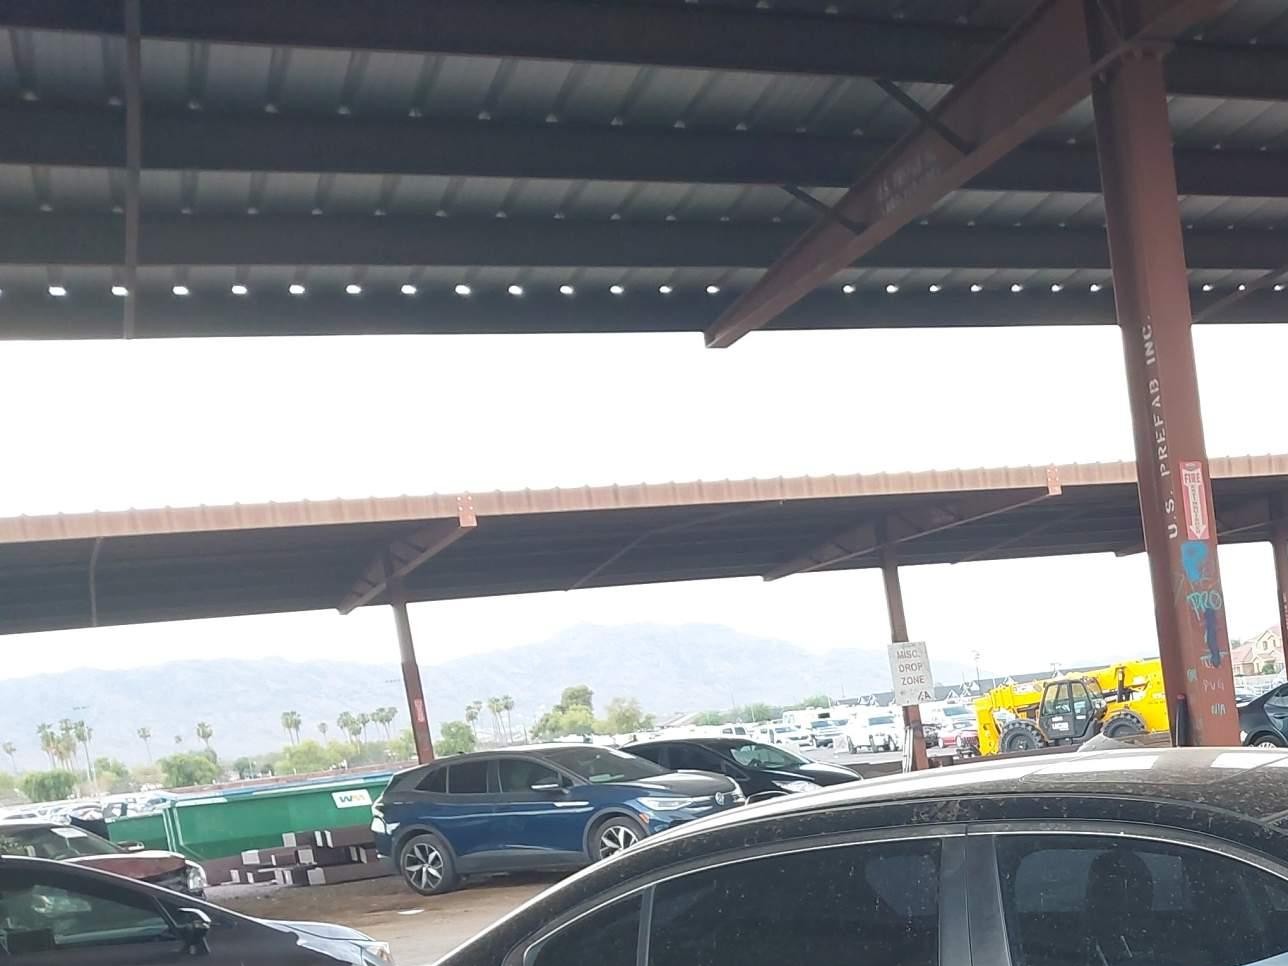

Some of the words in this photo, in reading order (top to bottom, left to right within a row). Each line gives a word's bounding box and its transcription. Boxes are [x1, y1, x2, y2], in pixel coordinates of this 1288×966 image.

[1141, 314, 1157, 366] INC.
[1149, 378, 1172, 479] PREFAB
[1184, 472, 1201, 484] FIRE
[1163, 490, 1178, 540] U.S.
[896, 649, 921, 660] MISC.
[898, 662, 923, 673] DROP
[900, 675, 926, 686] ZONE
